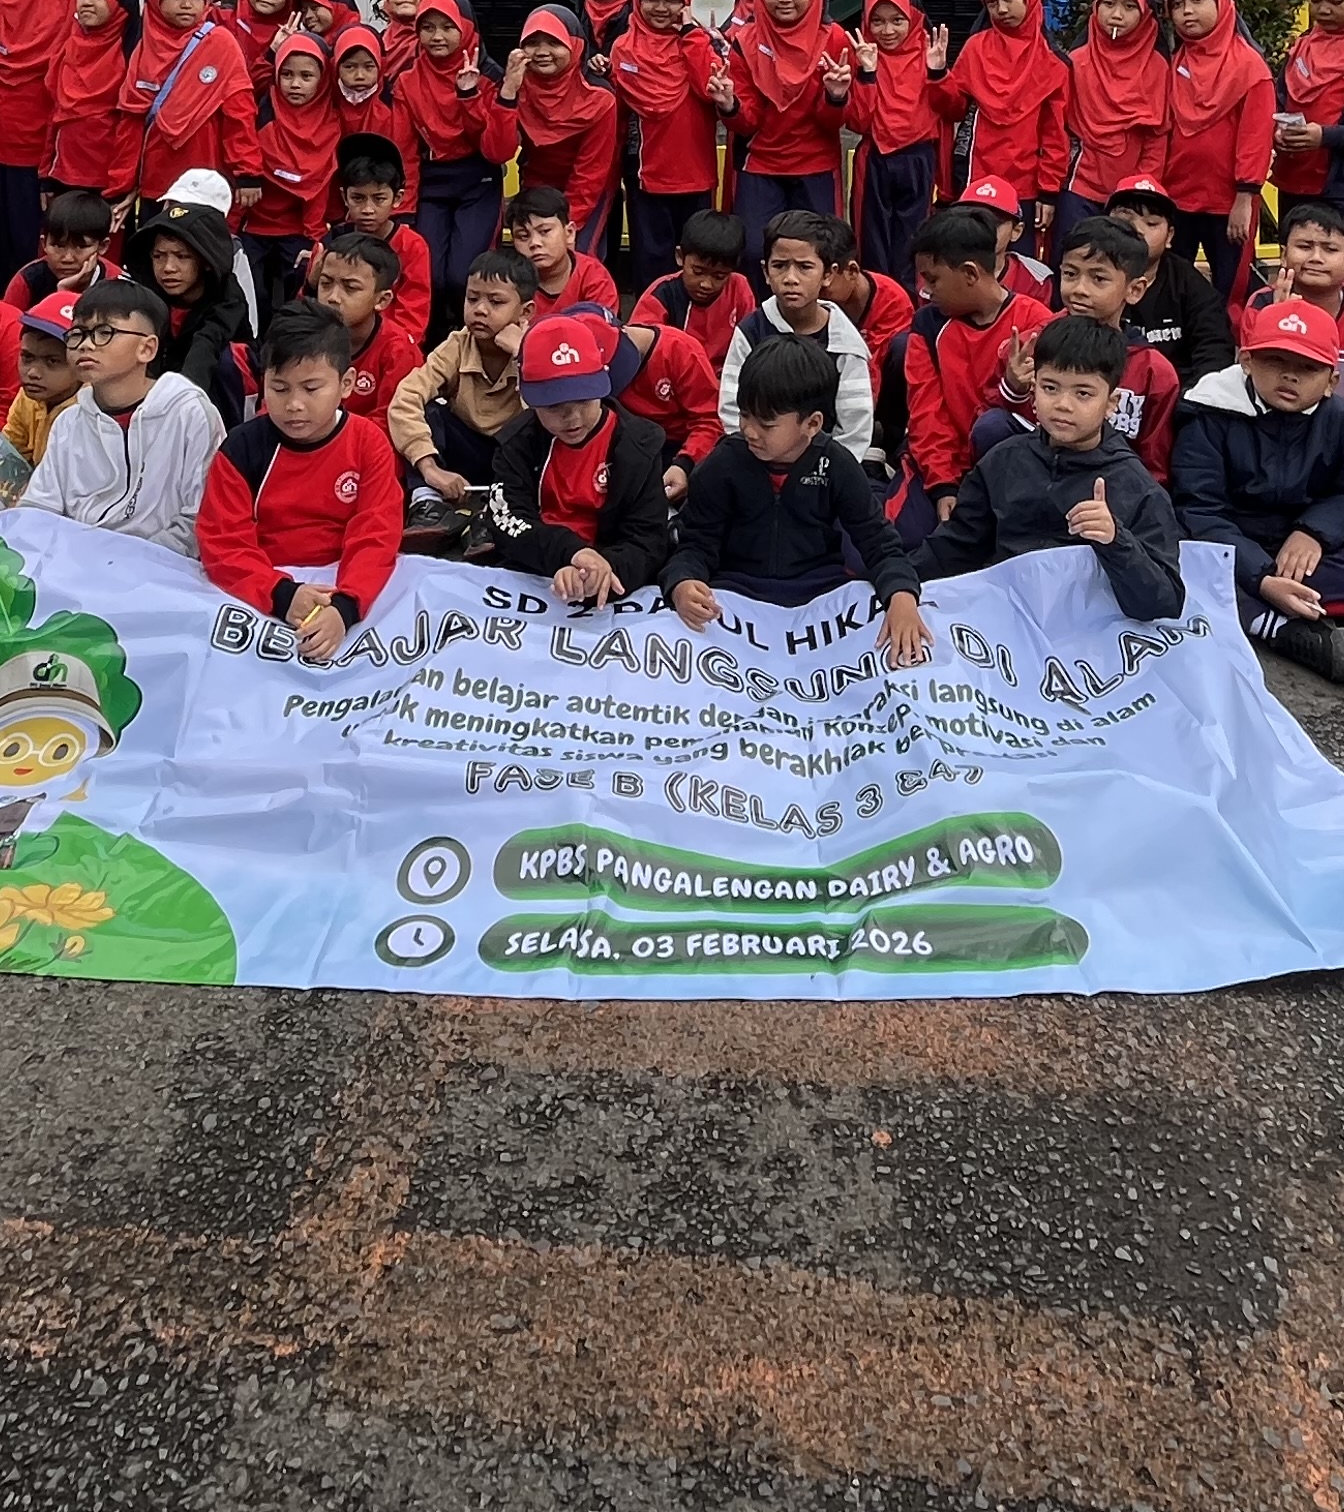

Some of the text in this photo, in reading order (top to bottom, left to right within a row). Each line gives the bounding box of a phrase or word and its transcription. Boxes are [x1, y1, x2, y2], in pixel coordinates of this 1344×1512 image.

[211, 603, 526, 669] BEAJAR
[949, 623, 1018, 688] DI
[482, 585, 548, 615] SD
[566, 600, 594, 619] 2
[613, 596, 770, 652] DAUL
[283, 667, 444, 722] Pengalaan
[452, 667, 559, 713] belajar
[566, 694, 690, 726] autentik
[929, 678, 1051, 736] langsung
[1056, 718, 1084, 732] di
[1090, 692, 1157, 728] alam
[424, 707, 635, 746] meningkatkan
[925, 711, 1044, 749] motivasi
[383, 729, 553, 758] kreativitas
[560, 749, 644, 762] siswa
[653, 741, 729, 765] yang
[739, 737, 886, 779] berakhlak
[612, 771, 644, 798] B
[856, 783, 884, 818] 3
[519, 834, 1035, 900] KPBS PANGALENGAN DAIRY & AGRO
[631, 935, 675, 959] 03
[686, 933, 841, 960] FEBRUARI
[851, 928, 933, 955] 2026
